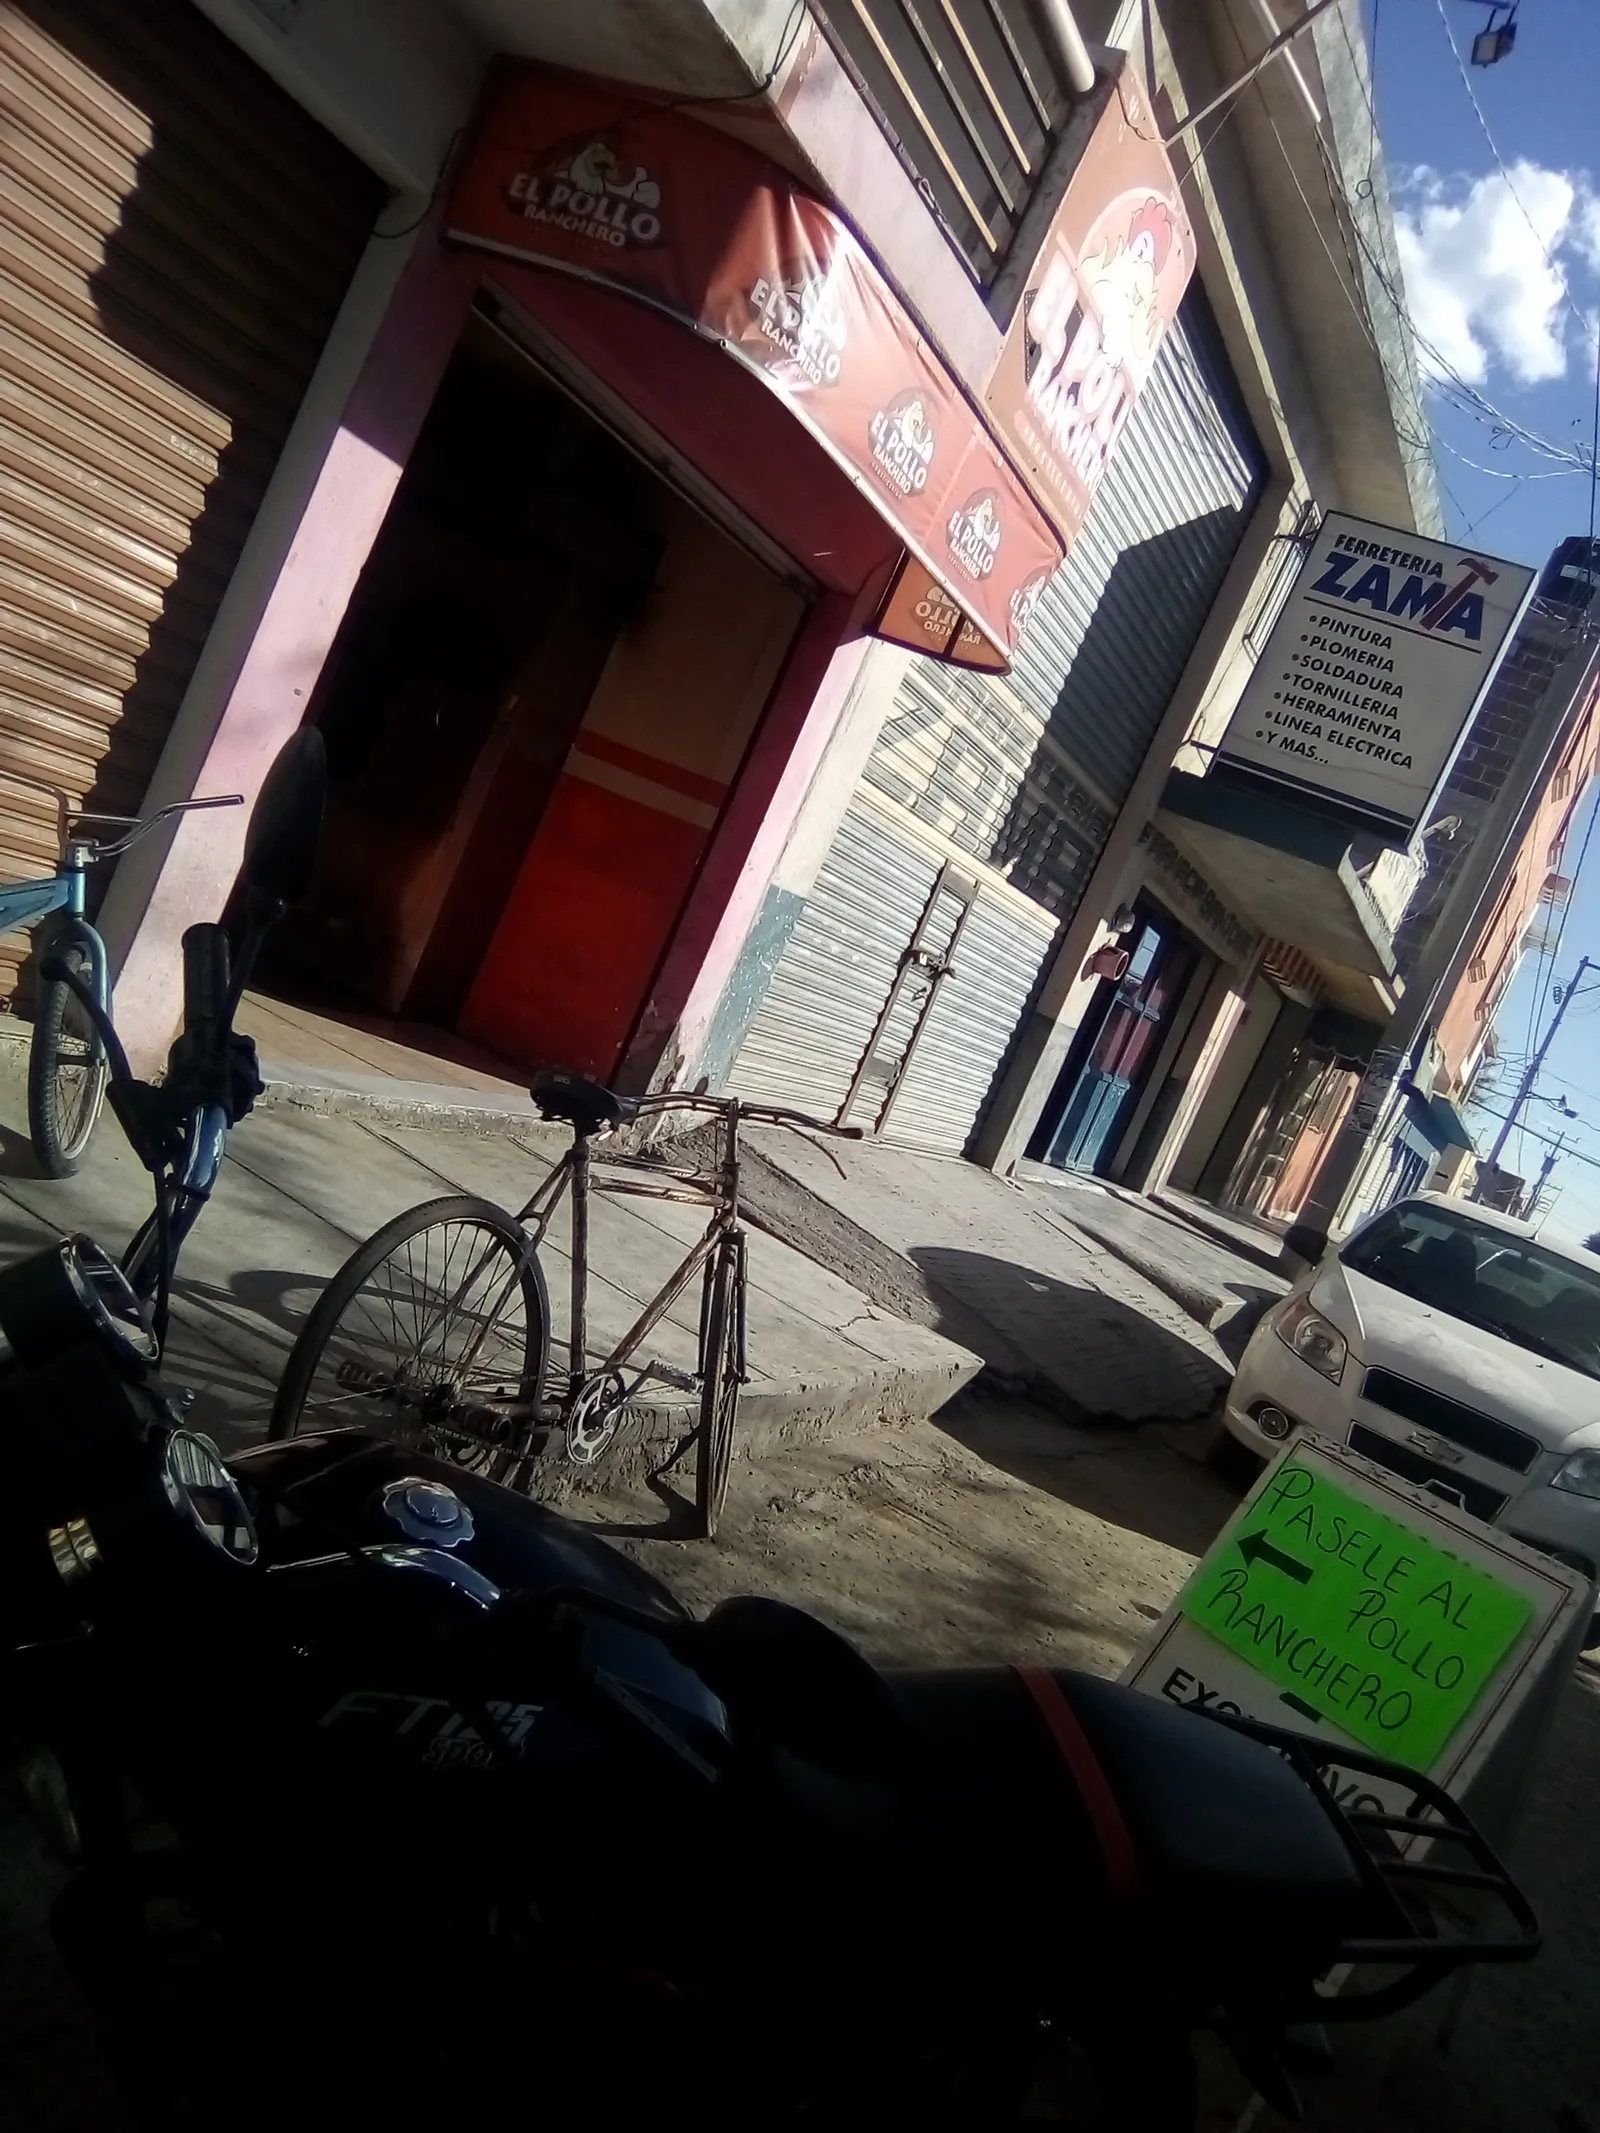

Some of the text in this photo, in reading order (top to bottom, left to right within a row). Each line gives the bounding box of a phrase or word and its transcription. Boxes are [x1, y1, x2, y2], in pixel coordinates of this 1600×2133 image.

[509, 172, 541, 202] EL
[549, 184, 661, 241] POLLO
[524, 204, 626, 247] RANCHERO
[750, 278, 778, 319] EL
[870, 410, 928, 489] EL POLLO
[873, 442, 912, 494] RANCHERO
[948, 510, 964, 539] EL
[960, 528, 995, 573] POLLO
[950, 537, 981, 579] RANCHERO
[1333, 533, 1443, 579] FERRETERIA
[1309, 551, 1485, 641] ZAMA
[1308, 635, 1395, 673] PLOMERIA
[1317, 615, 1393, 650] PINTURA
[1291, 673, 1399, 720] TORNILLERIA
[1299, 654, 1404, 699] SOLDADURA
[1272, 711, 1414, 770] LINEA ELECTRICA
[1281, 692, 1402, 743] HERRAMIENTA
[1265, 730, 1329, 765] Y MAS...
[1268, 1467, 1470, 1631] PASELE AL
[1206, 1567, 1413, 1731] RANCHERO
[1346, 1588, 1465, 1691] POLLO
